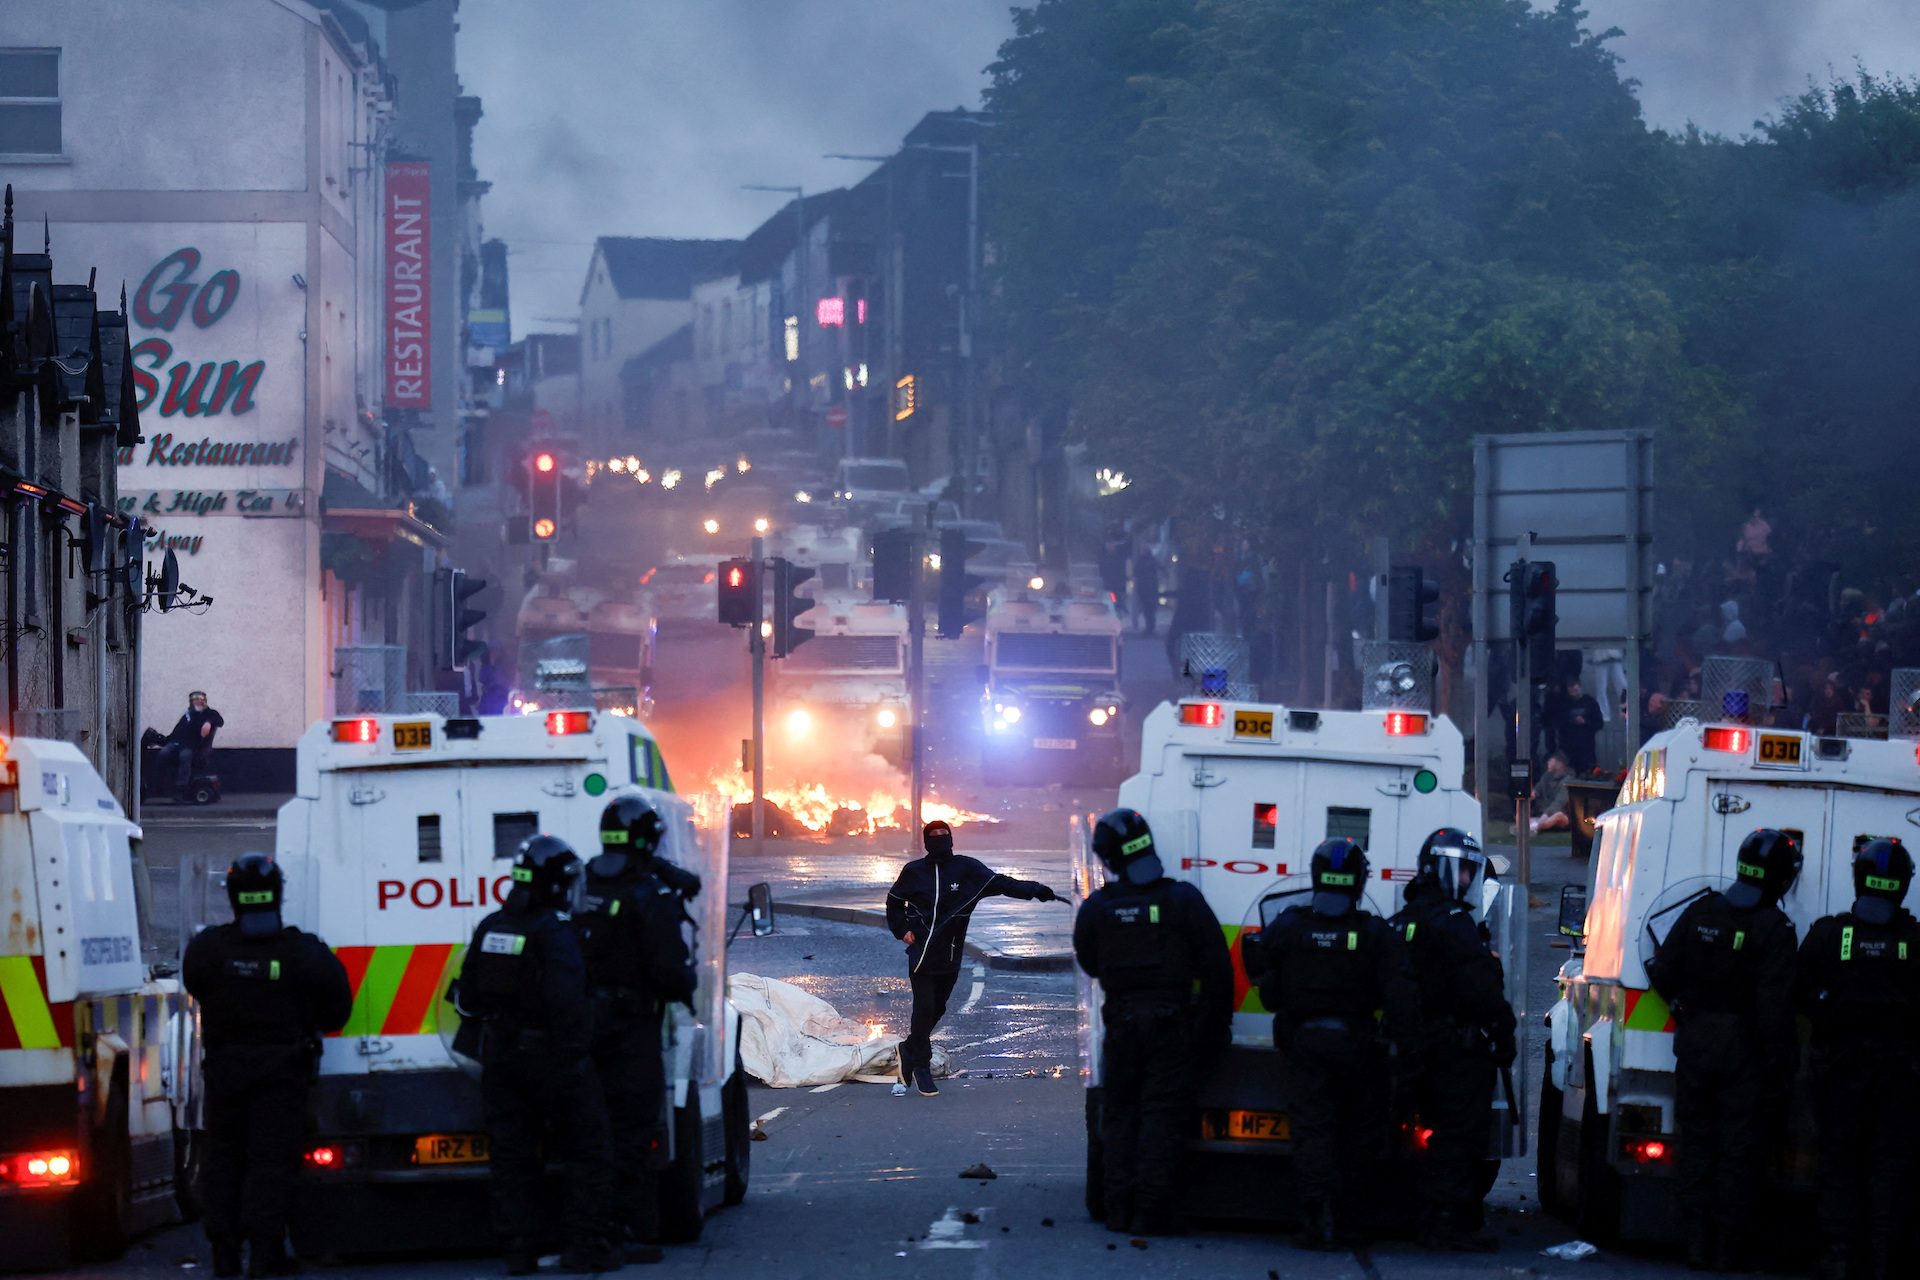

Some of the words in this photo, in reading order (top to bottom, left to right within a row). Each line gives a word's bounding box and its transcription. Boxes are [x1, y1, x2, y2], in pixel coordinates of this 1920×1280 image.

[132, 247, 241, 332] Go
[394, 194, 422, 399] RESTAURANT
[129, 338, 265, 418] Sun
[147, 433, 298, 467] Restaurant
[143, 492, 161, 515] &
[166, 491, 228, 517] High
[236, 491, 273, 512] Tea
[1181, 858, 1418, 882] POLE
[378, 875, 512, 910] POLIC
[1312, 933, 1337, 941] POLICE
[1242, 1115, 1281, 1136] MFZ
